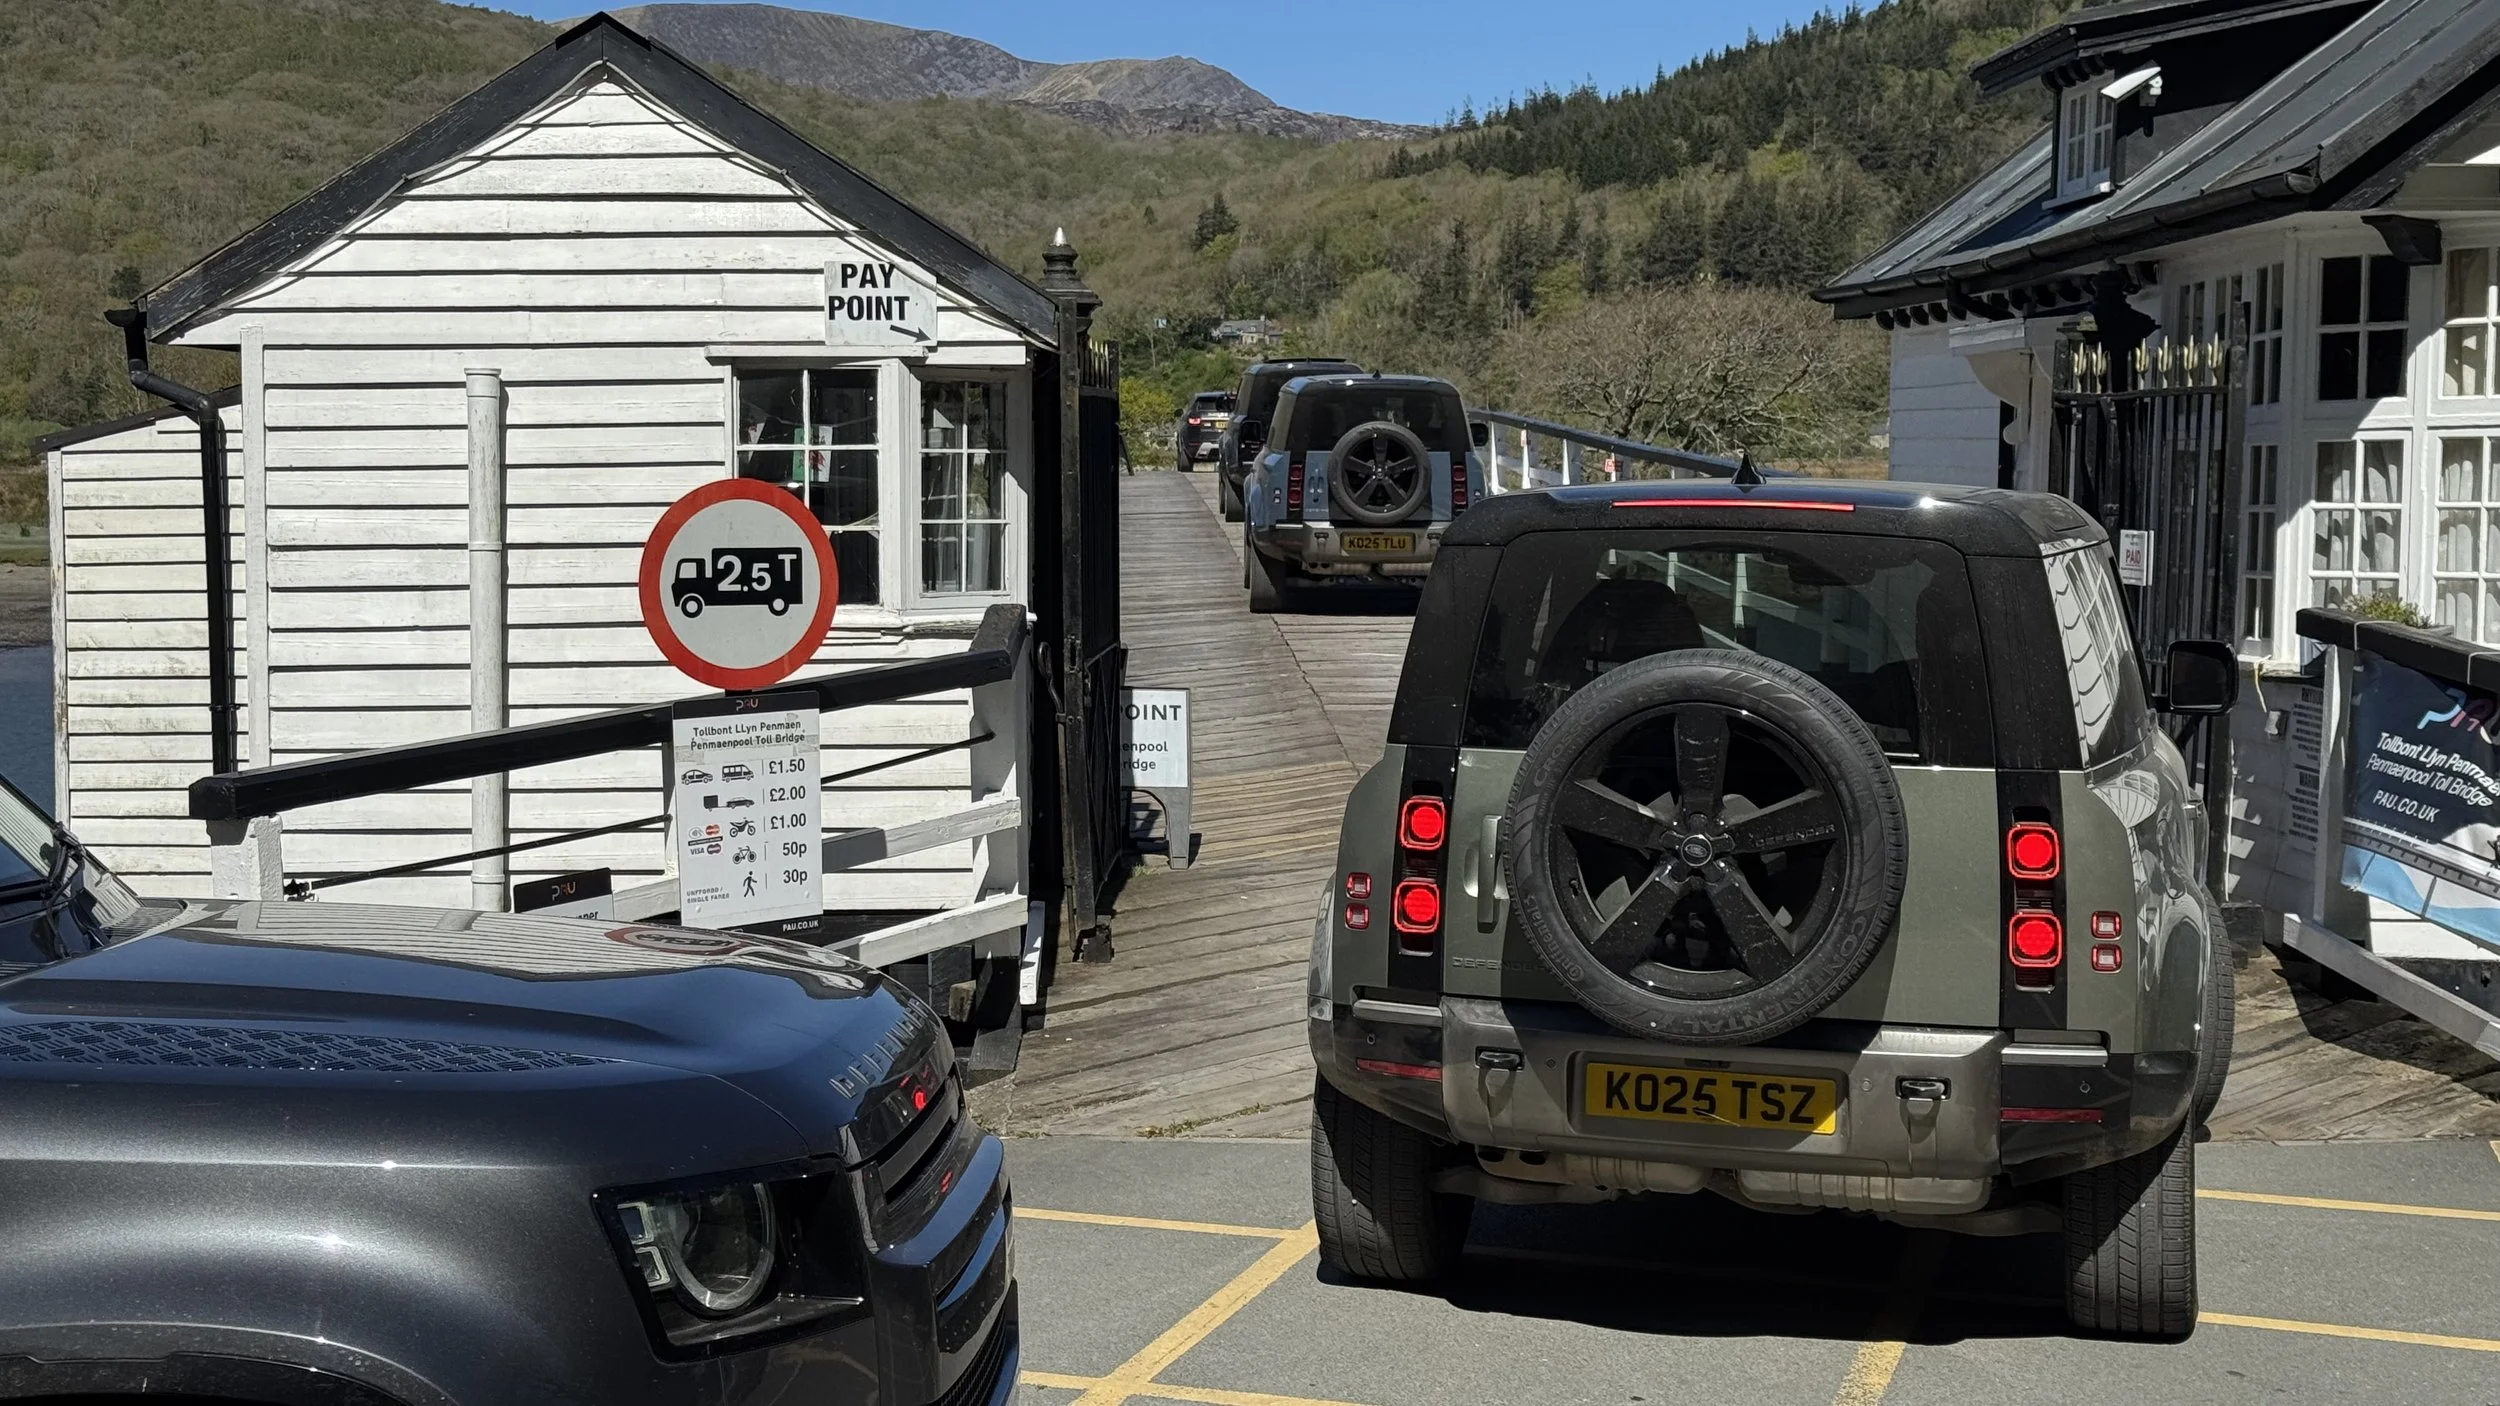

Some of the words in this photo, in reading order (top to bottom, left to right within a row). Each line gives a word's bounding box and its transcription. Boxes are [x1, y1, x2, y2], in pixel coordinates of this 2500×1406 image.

[841, 264, 895, 289] PAY
[828, 295, 910, 321] POINT
[1384, 537, 1406, 549] TLU
[1120, 704, 1182, 721] OINT
[693, 725, 732, 737] Tollbont
[760, 721, 801, 732] Penmaen
[690, 736, 753, 751] Penmaenpool
[755, 735, 773, 745] Toll
[775, 732, 805, 743] Bridge
[1122, 741, 1169, 753] enpool
[2376, 731, 2423, 760] Tollbont
[2418, 744, 2449, 768] Llyn
[769, 758, 806, 774] £1.50
[1122, 758, 1157, 772] ridge
[2365, 752, 2435, 786] Penmaenpool
[2430, 771, 2455, 793] Toll
[2447, 776, 2494, 807] Bridge
[769, 785, 806, 802] £2.00
[2372, 789, 2441, 823] PAU.CO.UK
[770, 813, 807, 830] £1.00
[690, 847, 705, 855] VISA
[782, 841, 807, 858] 50p
[783, 869, 808, 885] 30p
[782, 919, 819, 932] PAU.CO.UK
[1605, 1070, 1718, 1121] KO25
[1731, 1079, 1816, 1125] TSZ
